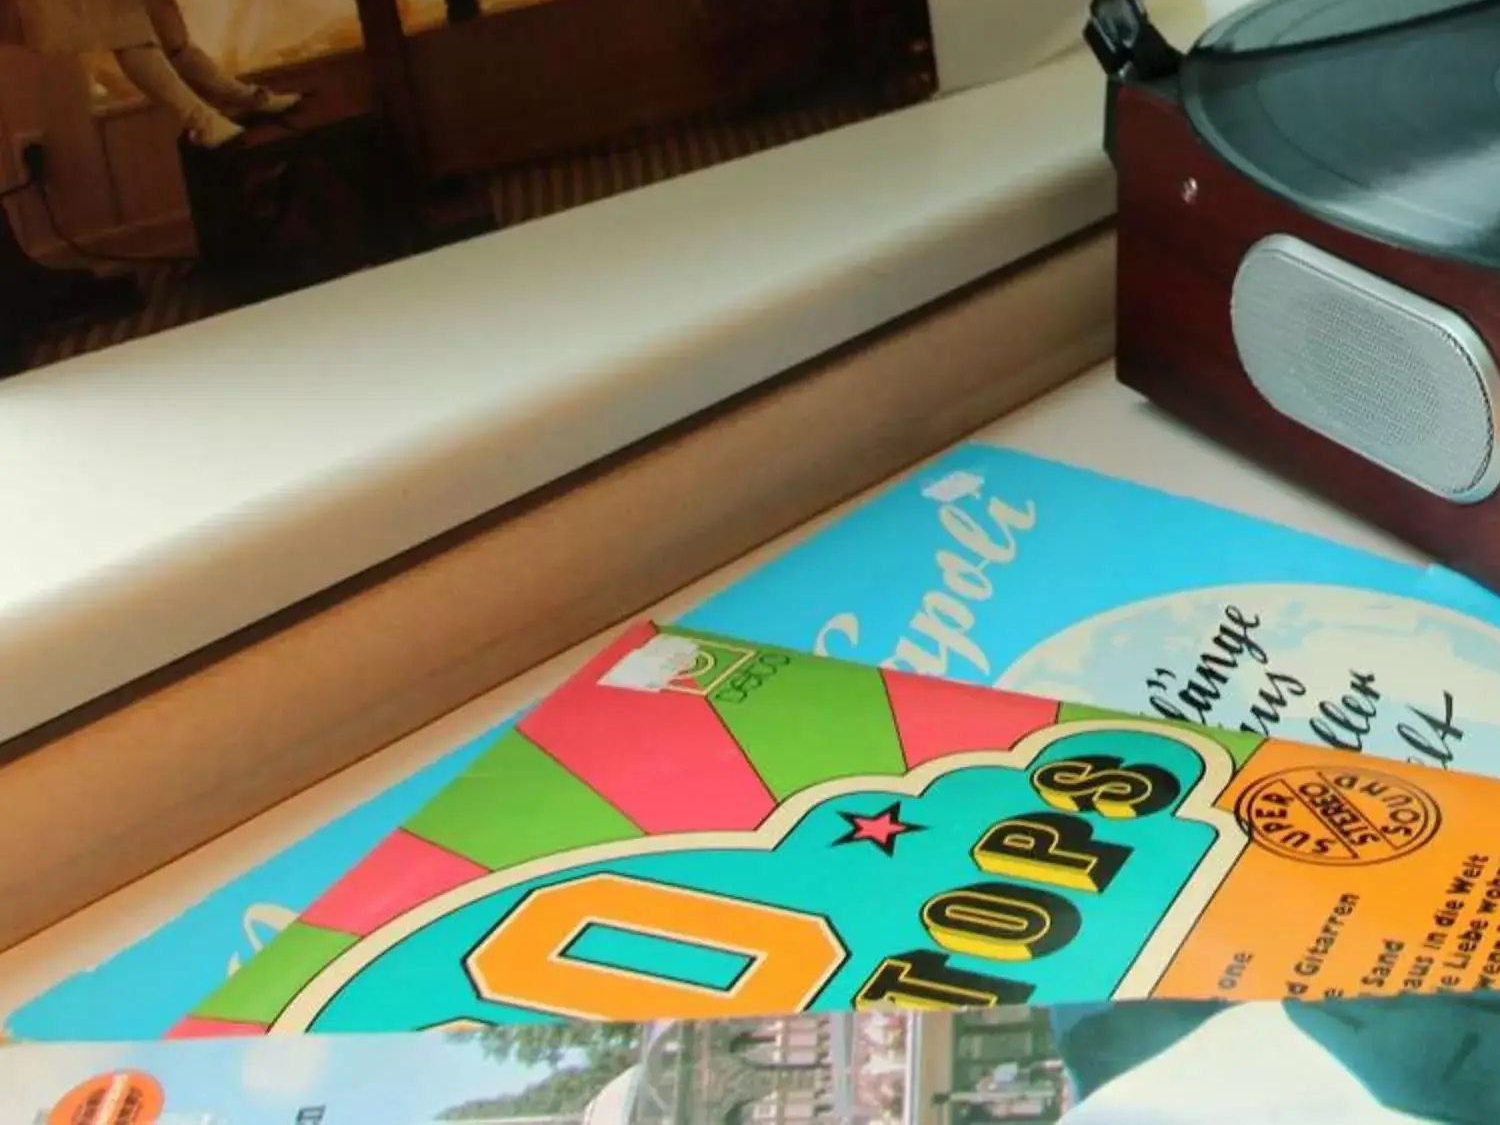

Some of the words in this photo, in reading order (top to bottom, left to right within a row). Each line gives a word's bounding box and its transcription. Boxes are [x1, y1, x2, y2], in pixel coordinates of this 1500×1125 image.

[814, 495, 1036, 677] apoli
[1148, 604, 1269, 725] länge
[1309, 668, 1381, 752] ller
[1255, 792, 1337, 855] SUPER
[1299, 782, 1381, 847] STEREO
[1333, 774, 1421, 837] SOUND
[1445, 854, 1489, 895] Welt
[1294, 892, 1360, 976] Gitarren
[1423, 931, 1448, 950] in
[1434, 899, 1465, 927] die
[1443, 919, 1489, 970] Liebe
[1361, 938, 1405, 988] Sand
[1403, 954, 1435, 990] aus
